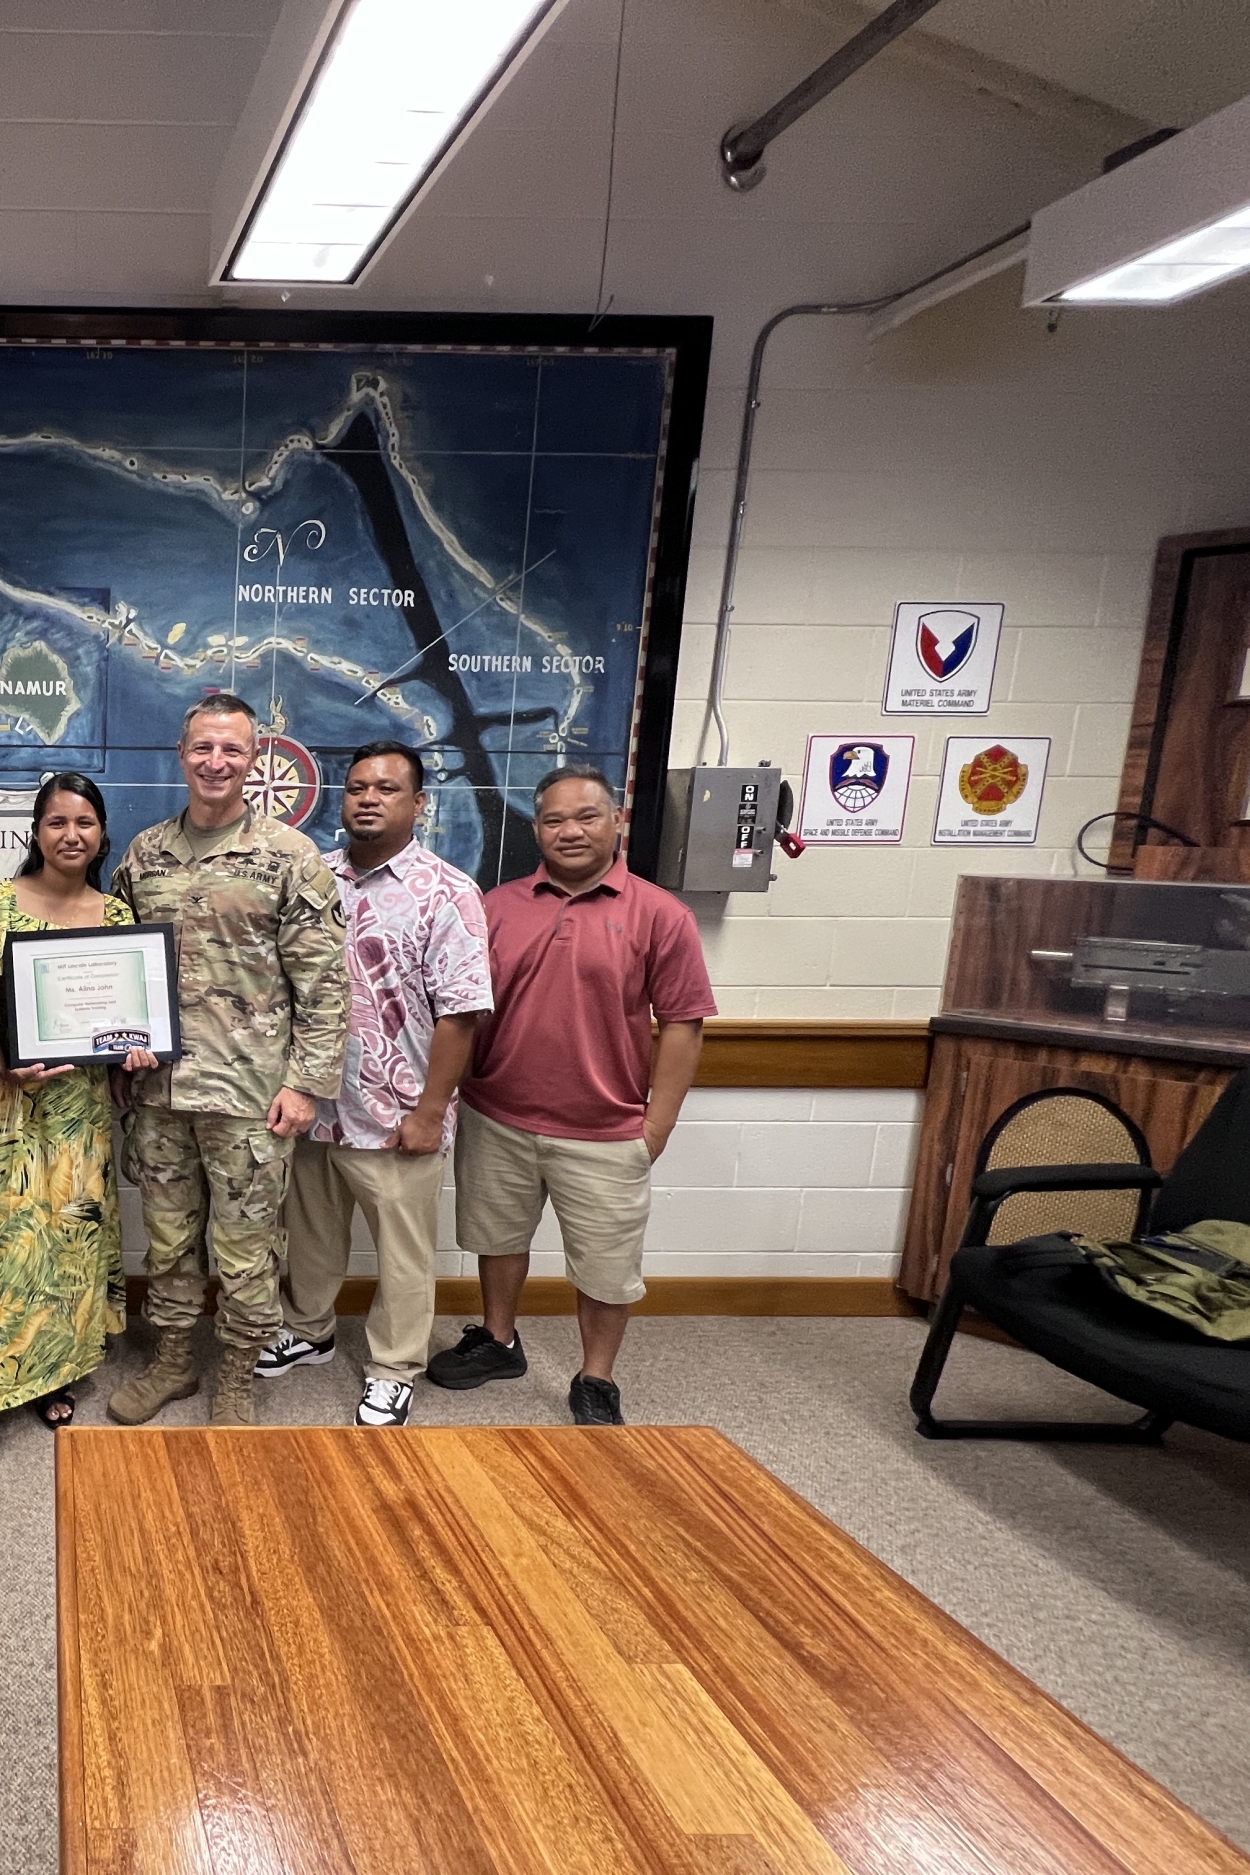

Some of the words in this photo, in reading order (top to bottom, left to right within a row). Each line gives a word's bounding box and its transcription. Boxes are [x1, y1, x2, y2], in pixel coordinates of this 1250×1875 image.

[238, 584, 332, 604] NORTHERN
[349, 588, 415, 607] SECTOR
[448, 654, 532, 672] SOUTHERN
[542, 655, 605, 674] SECTOR
[0, 680, 67, 696] NAMUR
[901, 689, 926, 697] UNITED
[929, 689, 954, 697] STATES
[957, 689, 978, 697] ARMY
[902, 699, 934, 707] MATERIEL
[745, 786, 754, 801] ON
[740, 826, 750, 849] OFF
[250, 872, 278, 884] ARMY
[96, 1034, 113, 1045] TEAM
